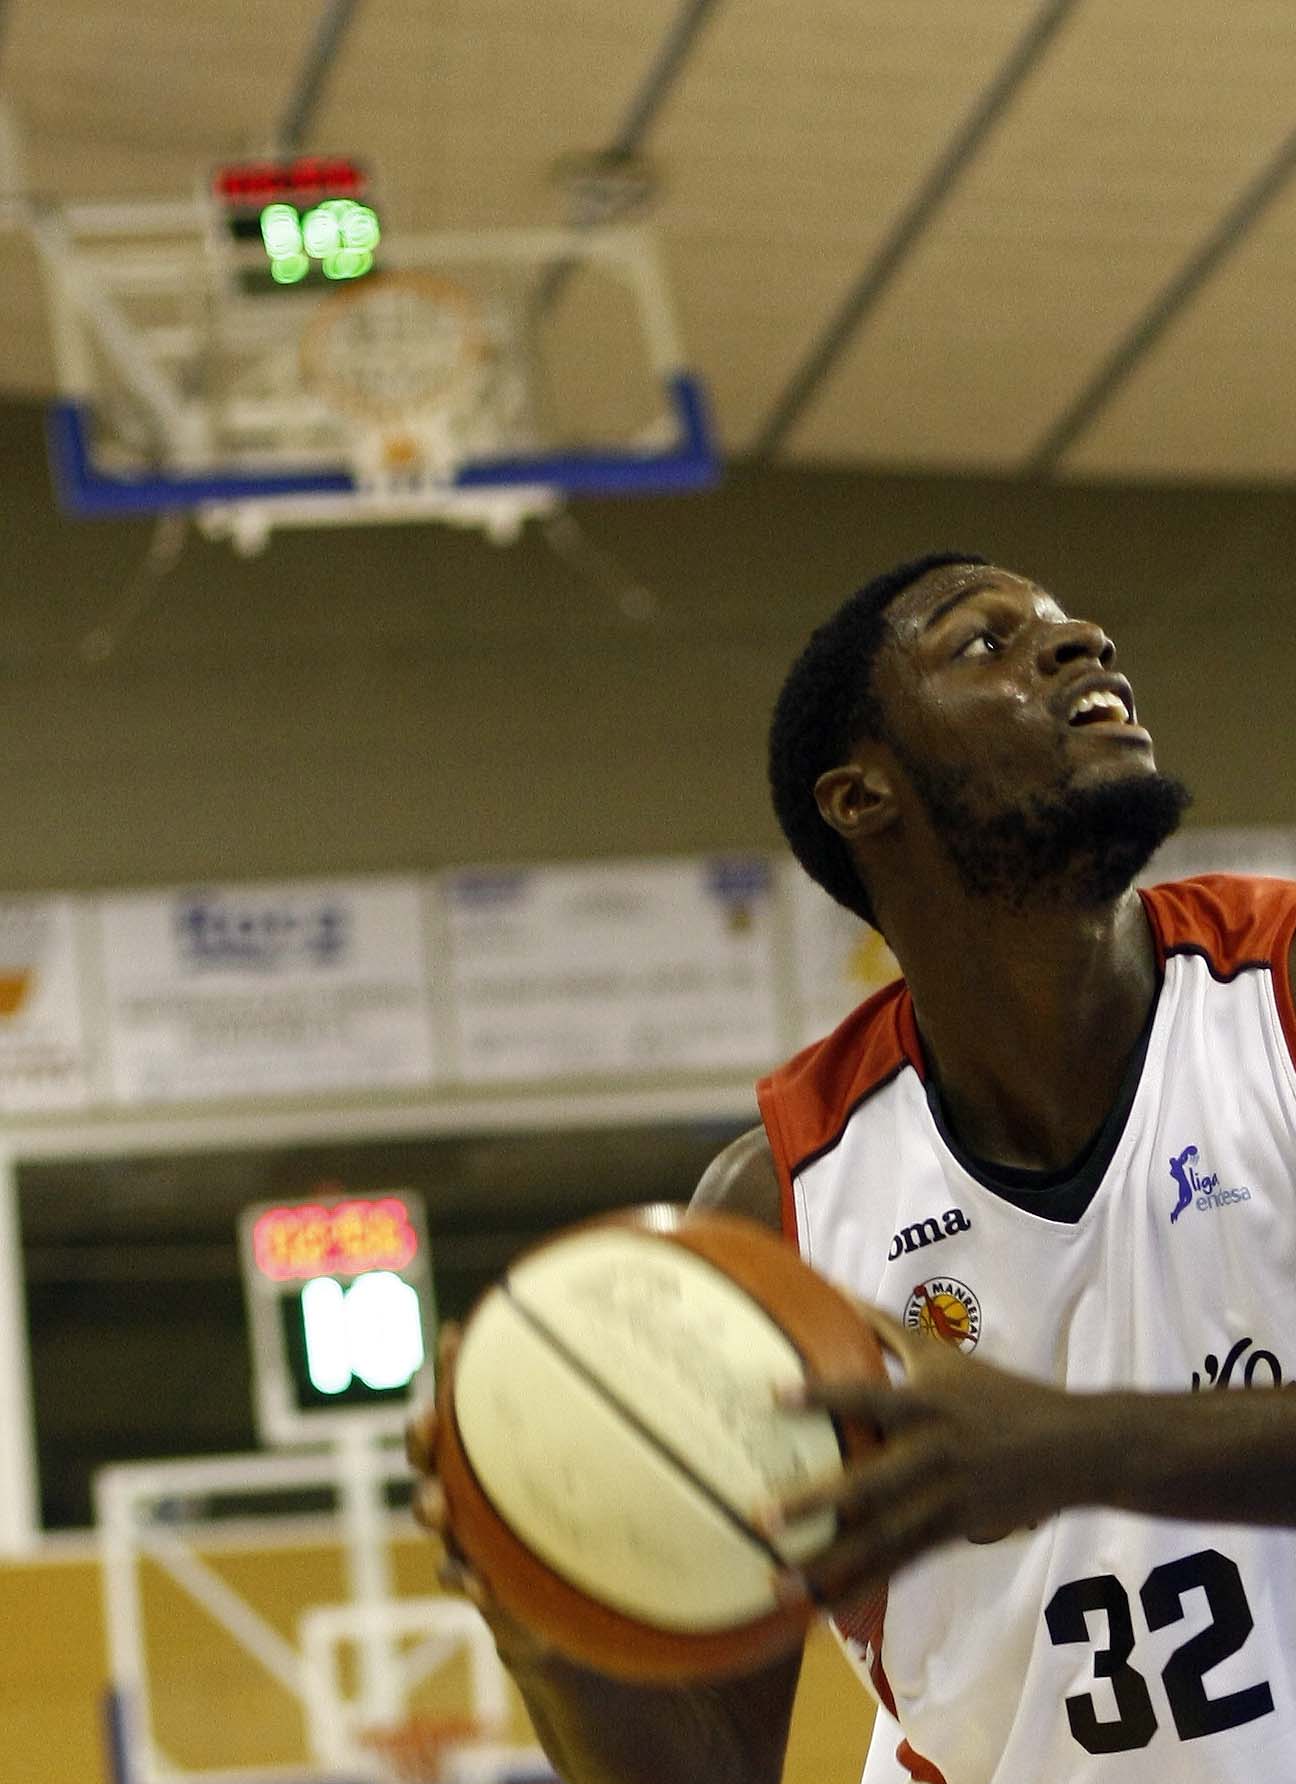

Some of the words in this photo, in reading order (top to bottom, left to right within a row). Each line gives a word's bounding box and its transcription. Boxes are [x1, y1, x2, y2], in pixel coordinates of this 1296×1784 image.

[1188, 1167, 1220, 1195] liga
[888, 1207, 972, 1262] oma
[931, 1282, 978, 1334] MANRESA
[1044, 1548, 1275, 1755] 32
